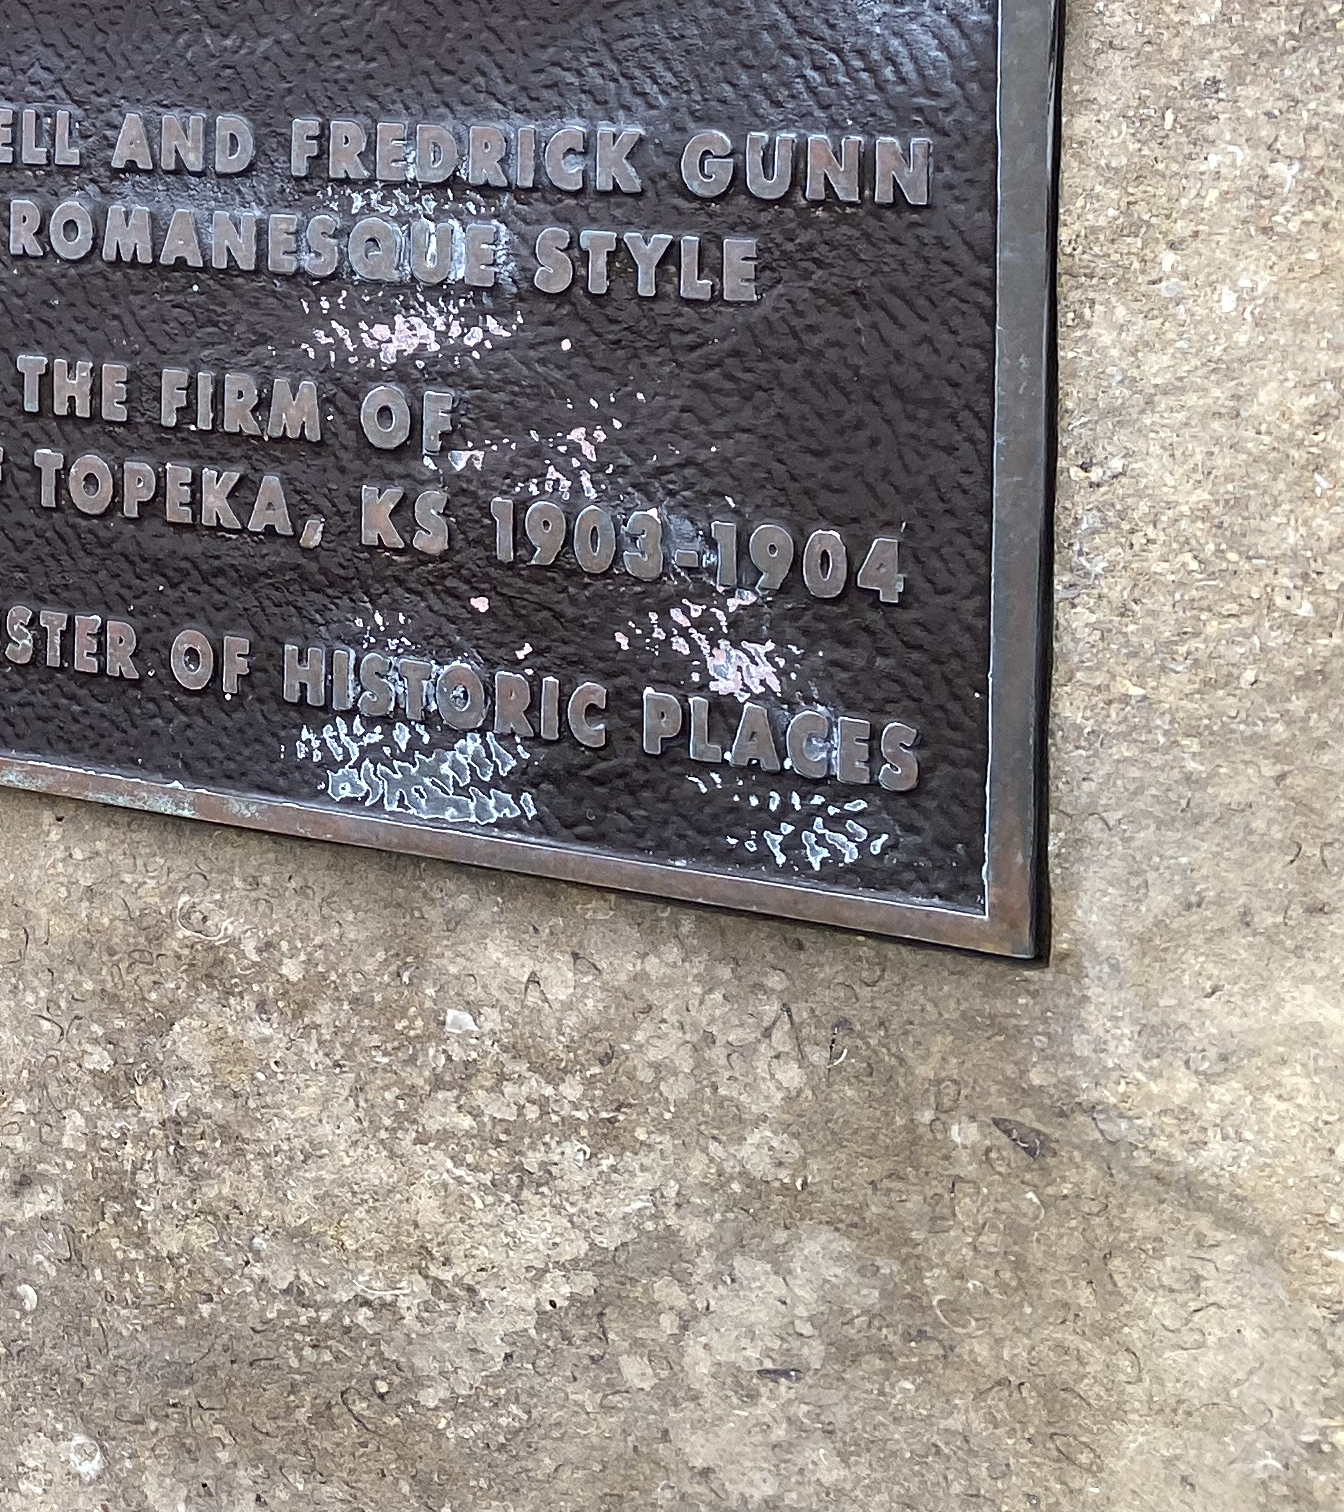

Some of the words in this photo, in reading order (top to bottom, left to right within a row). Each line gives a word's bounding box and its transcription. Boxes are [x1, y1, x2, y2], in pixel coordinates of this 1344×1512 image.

[111, 112, 255, 174] AND
[290, 116, 643, 194] FREDRICK
[681, 130, 932, 206] GUNN
[10, 199, 498, 287] ROMANESQUE
[534, 226, 759, 302] STYLE
[17, 354, 128, 423] THE
[160, 367, 322, 443] FIRM
[360, 386, 454, 456] OF
[34, 448, 325, 549] TOPEKA,
[360, 485, 449, 555] KS
[491, 497, 906, 604] 1903-1904
[171, 629, 250, 695] OF
[283, 644, 608, 748] HISTORIC
[642, 688, 919, 793] PLACES
